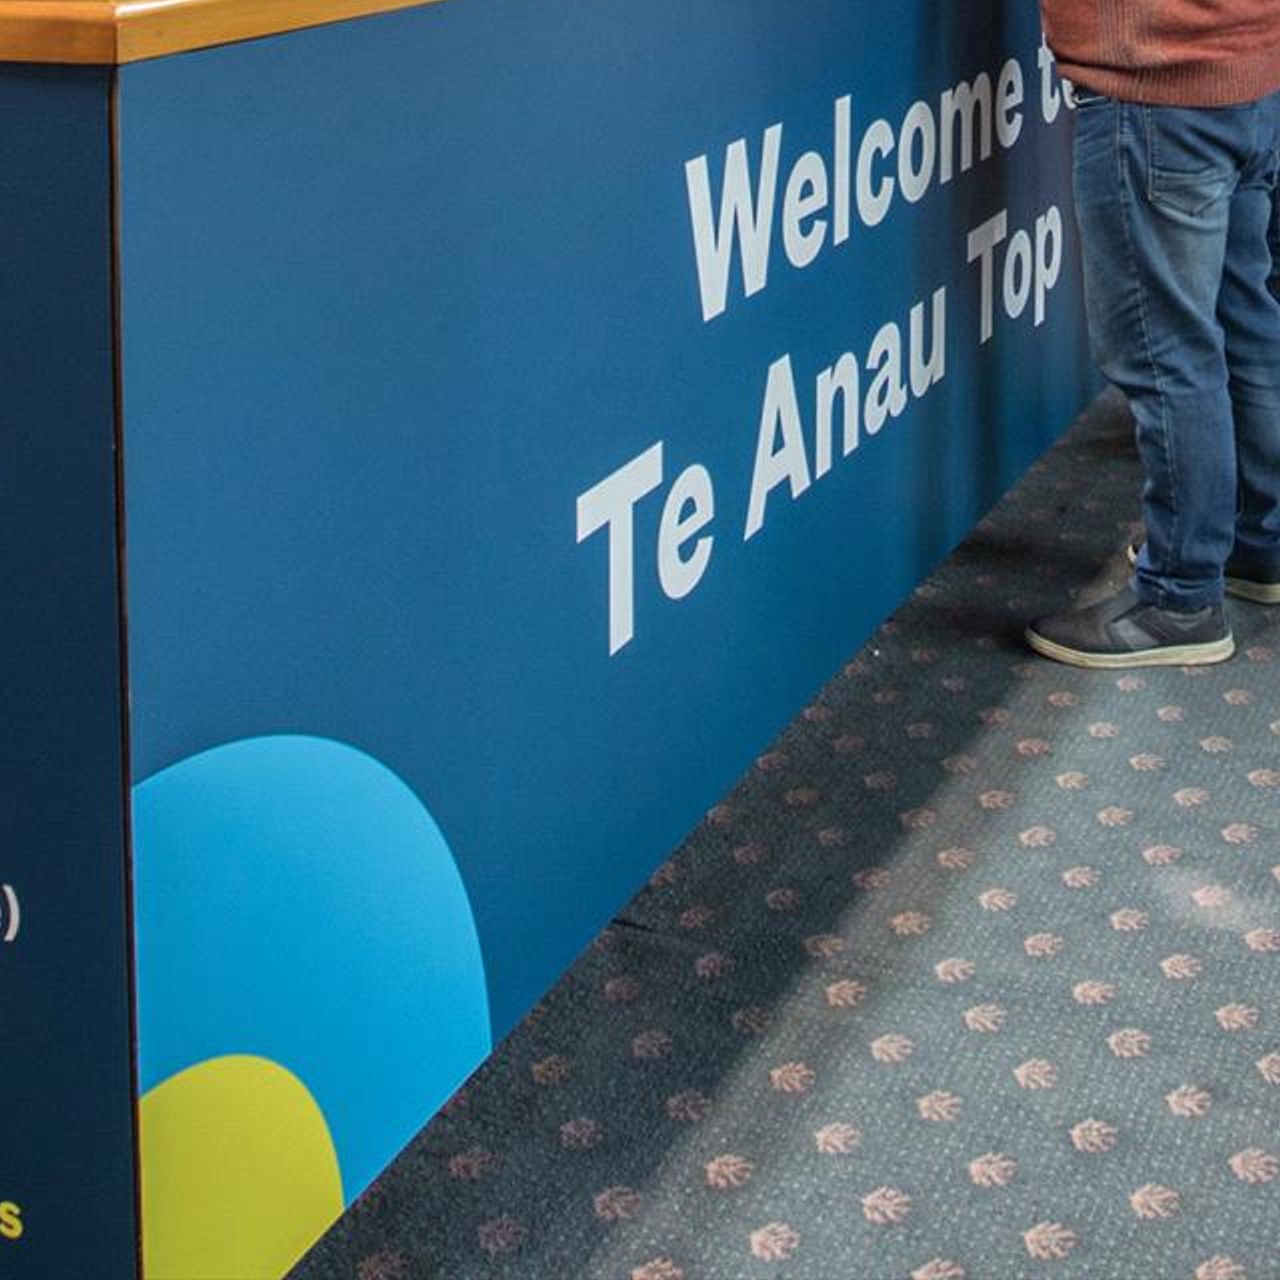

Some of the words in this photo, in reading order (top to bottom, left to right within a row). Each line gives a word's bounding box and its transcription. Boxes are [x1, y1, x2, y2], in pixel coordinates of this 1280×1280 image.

[684, 57, 1024, 323] Welcome
[575, 440, 715, 658] Te
[743, 286, 946, 542] Anau
[966, 204, 1062, 345] Top
